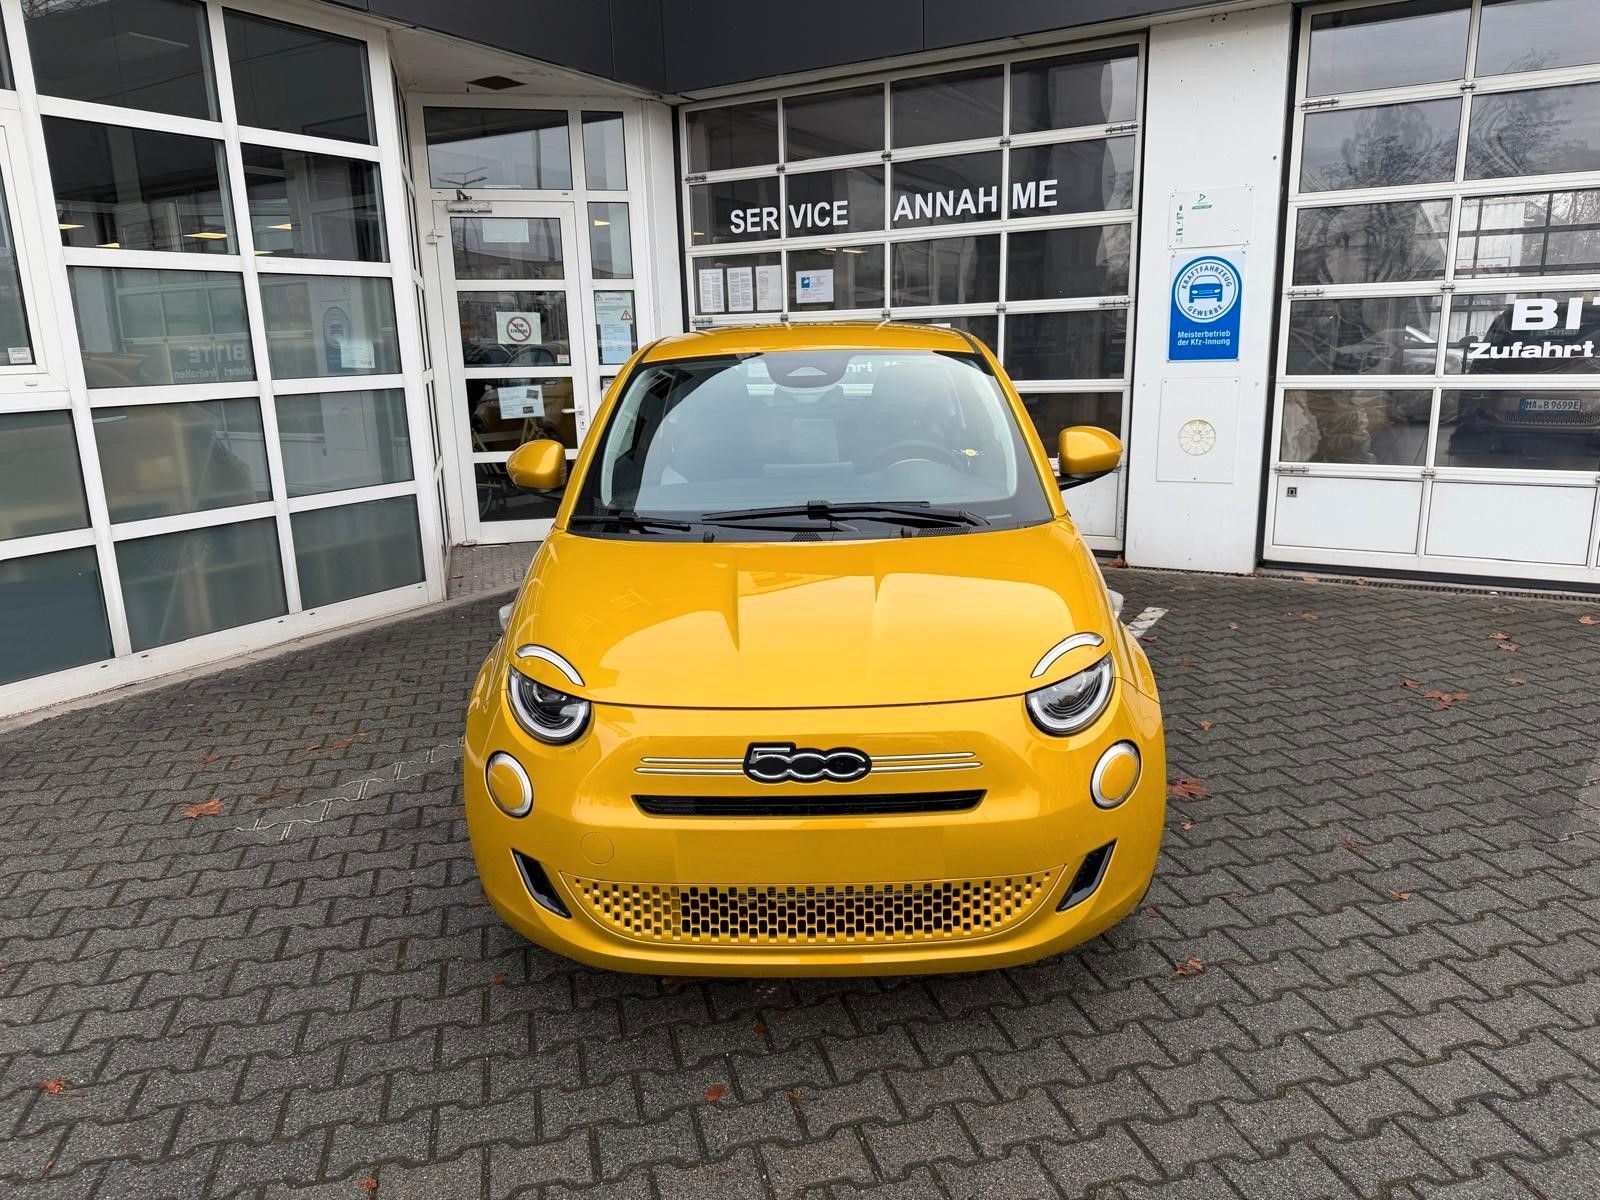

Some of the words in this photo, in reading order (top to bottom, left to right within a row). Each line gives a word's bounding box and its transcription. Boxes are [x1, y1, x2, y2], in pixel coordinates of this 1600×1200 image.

[730, 200, 848, 234] SERVICE
[893, 179, 1058, 221] ANNAHME
[1182, 265, 1232, 289] KRAFTFAHRZEUG
[1187, 304, 1223, 316] GEWERBE
[1177, 330, 1231, 339] Meisterbetrieb
[1190, 338, 1231, 346] Kfz-Innung
[1467, 340, 1595, 359] Zufahrt
[746, 745, 869, 781] 500
